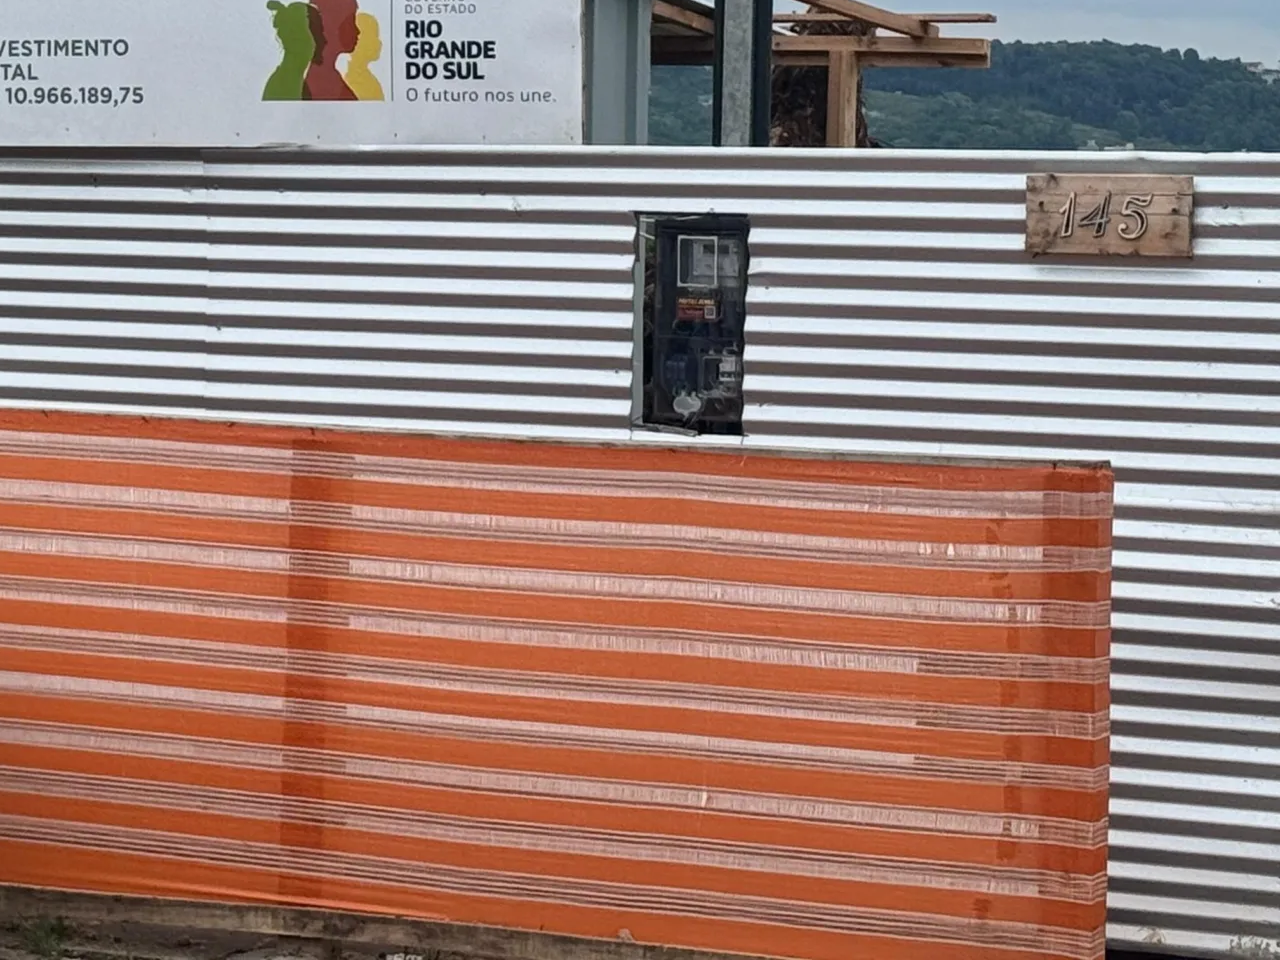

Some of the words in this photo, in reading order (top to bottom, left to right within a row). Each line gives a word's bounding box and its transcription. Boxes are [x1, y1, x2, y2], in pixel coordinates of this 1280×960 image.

[405, 4, 423, 14] DO
[428, 4, 476, 14] ESTADO
[406, 20, 442, 38] RIO
[405, 41, 496, 59] GRANDE
[406, 62, 437, 79] DO
[443, 62, 485, 79] SUL
[5, 87, 143, 107] 10.966.189,75
[406, 88, 418, 102] O
[424, 88, 478, 102] futuro
[485, 91, 514, 102] nos
[521, 92, 556, 102] une.
[1059, 191, 1153, 240] 145
